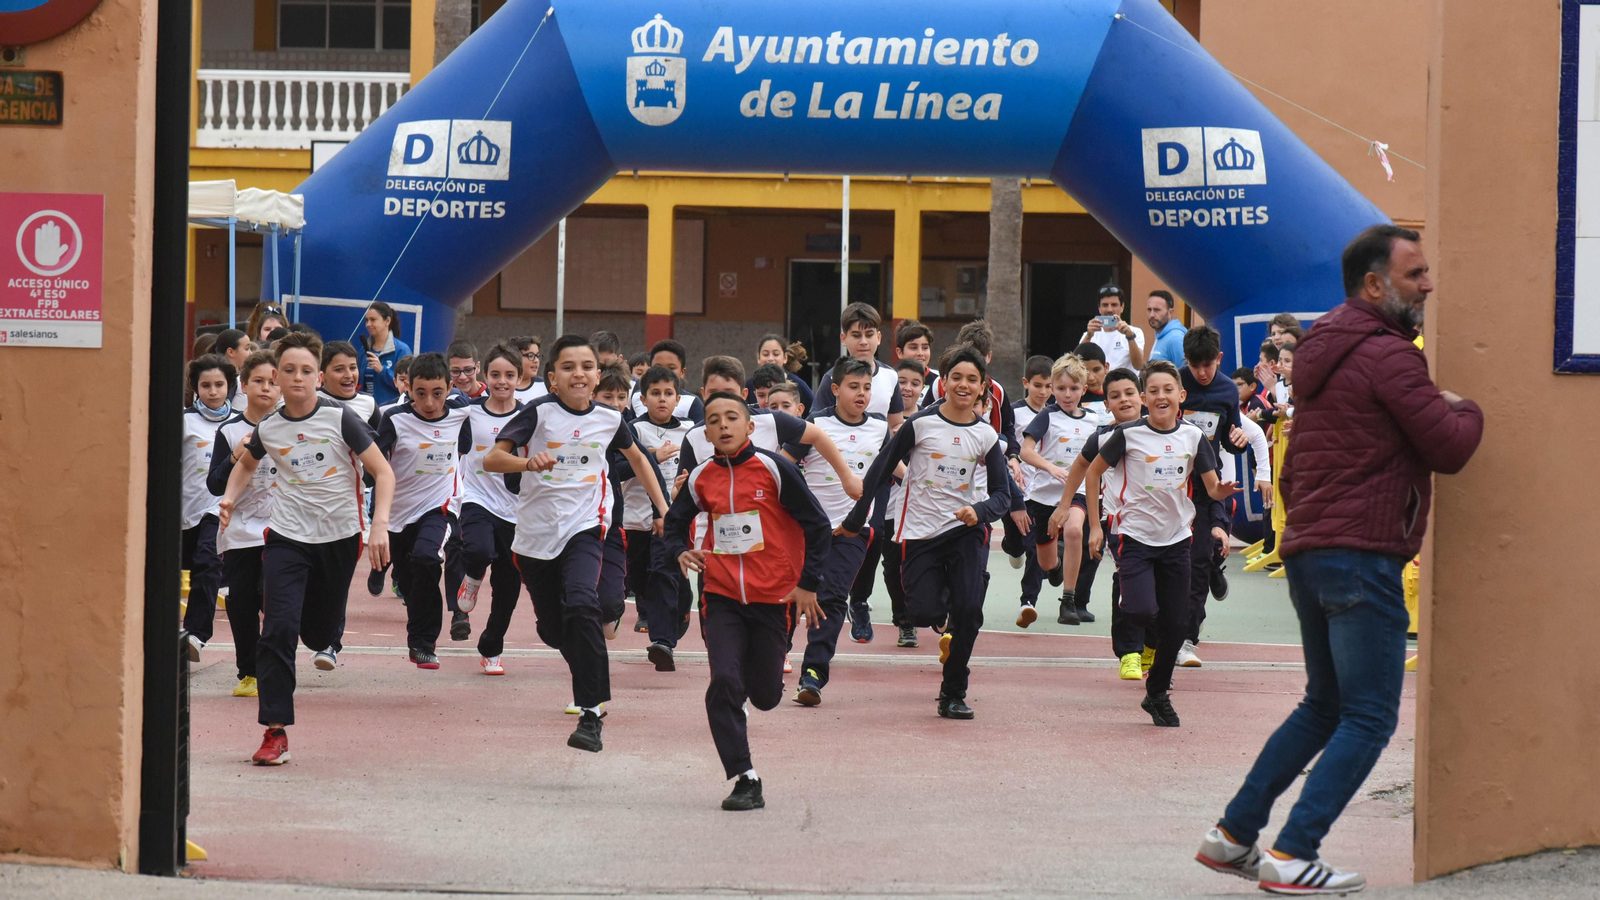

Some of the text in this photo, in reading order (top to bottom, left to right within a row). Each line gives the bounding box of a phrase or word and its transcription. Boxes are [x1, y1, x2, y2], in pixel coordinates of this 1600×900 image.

[702, 26, 1040, 74] Ayuntamiento
[35, 76, 54, 96] DE
[739, 79, 1003, 120] de La Línea
[403, 133, 434, 165] D
[1157, 141, 1189, 176] D
[385, 179, 486, 194] DELEGACIÓN DE
[1145, 187, 1245, 202] DELEGACIÓN DE
[384, 197, 506, 219] DEPORTES
[1148, 206, 1269, 227] DEPORTES
[8, 277, 89, 289] ACCESO ÚNICO
[37, 299, 59, 309] FPB
[44, 289, 66, 299] ESO
[10, 329, 58, 339] salesianos
